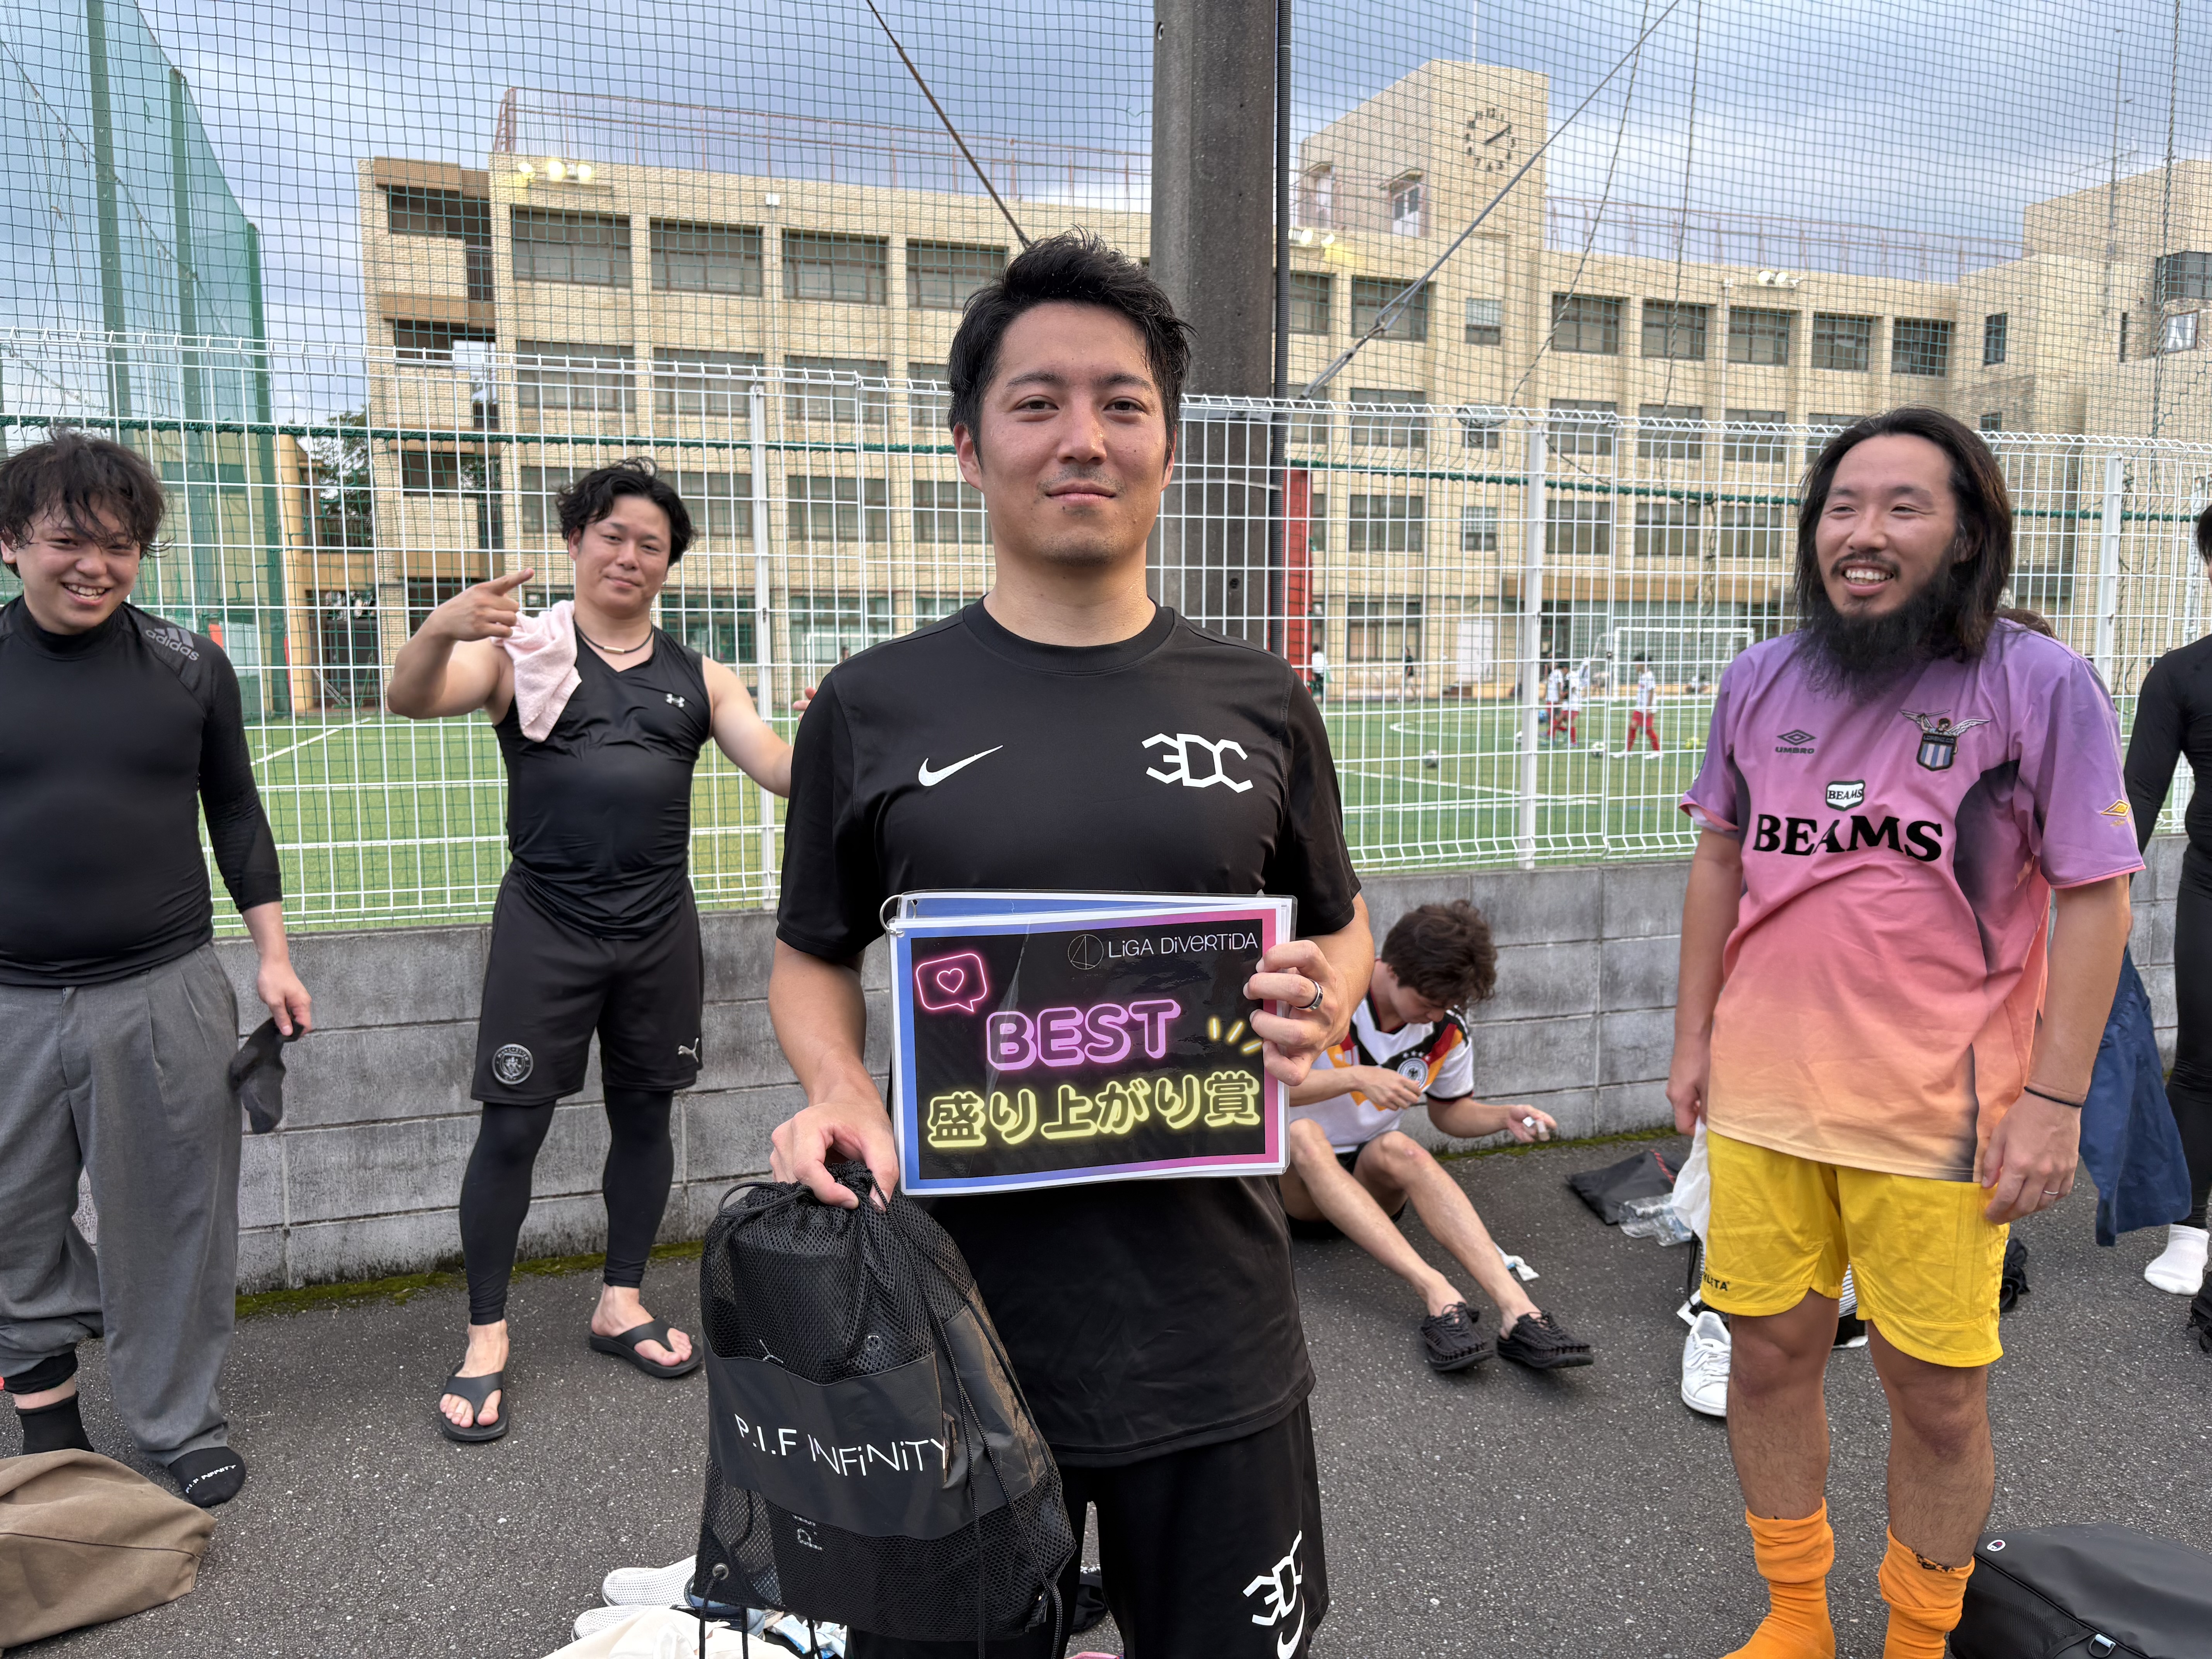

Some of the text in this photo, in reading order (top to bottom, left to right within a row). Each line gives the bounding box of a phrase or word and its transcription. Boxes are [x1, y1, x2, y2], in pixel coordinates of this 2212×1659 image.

[145, 629, 199, 661] adidas
[1828, 789, 1863, 800] BEAMS
[1753, 814, 1942, 862] BEAMS
[986, 1000, 1181, 1070] BEST
[928, 1070, 1261, 1148] 盛り上がり賞
[734, 1413, 797, 1456] P.I.F
